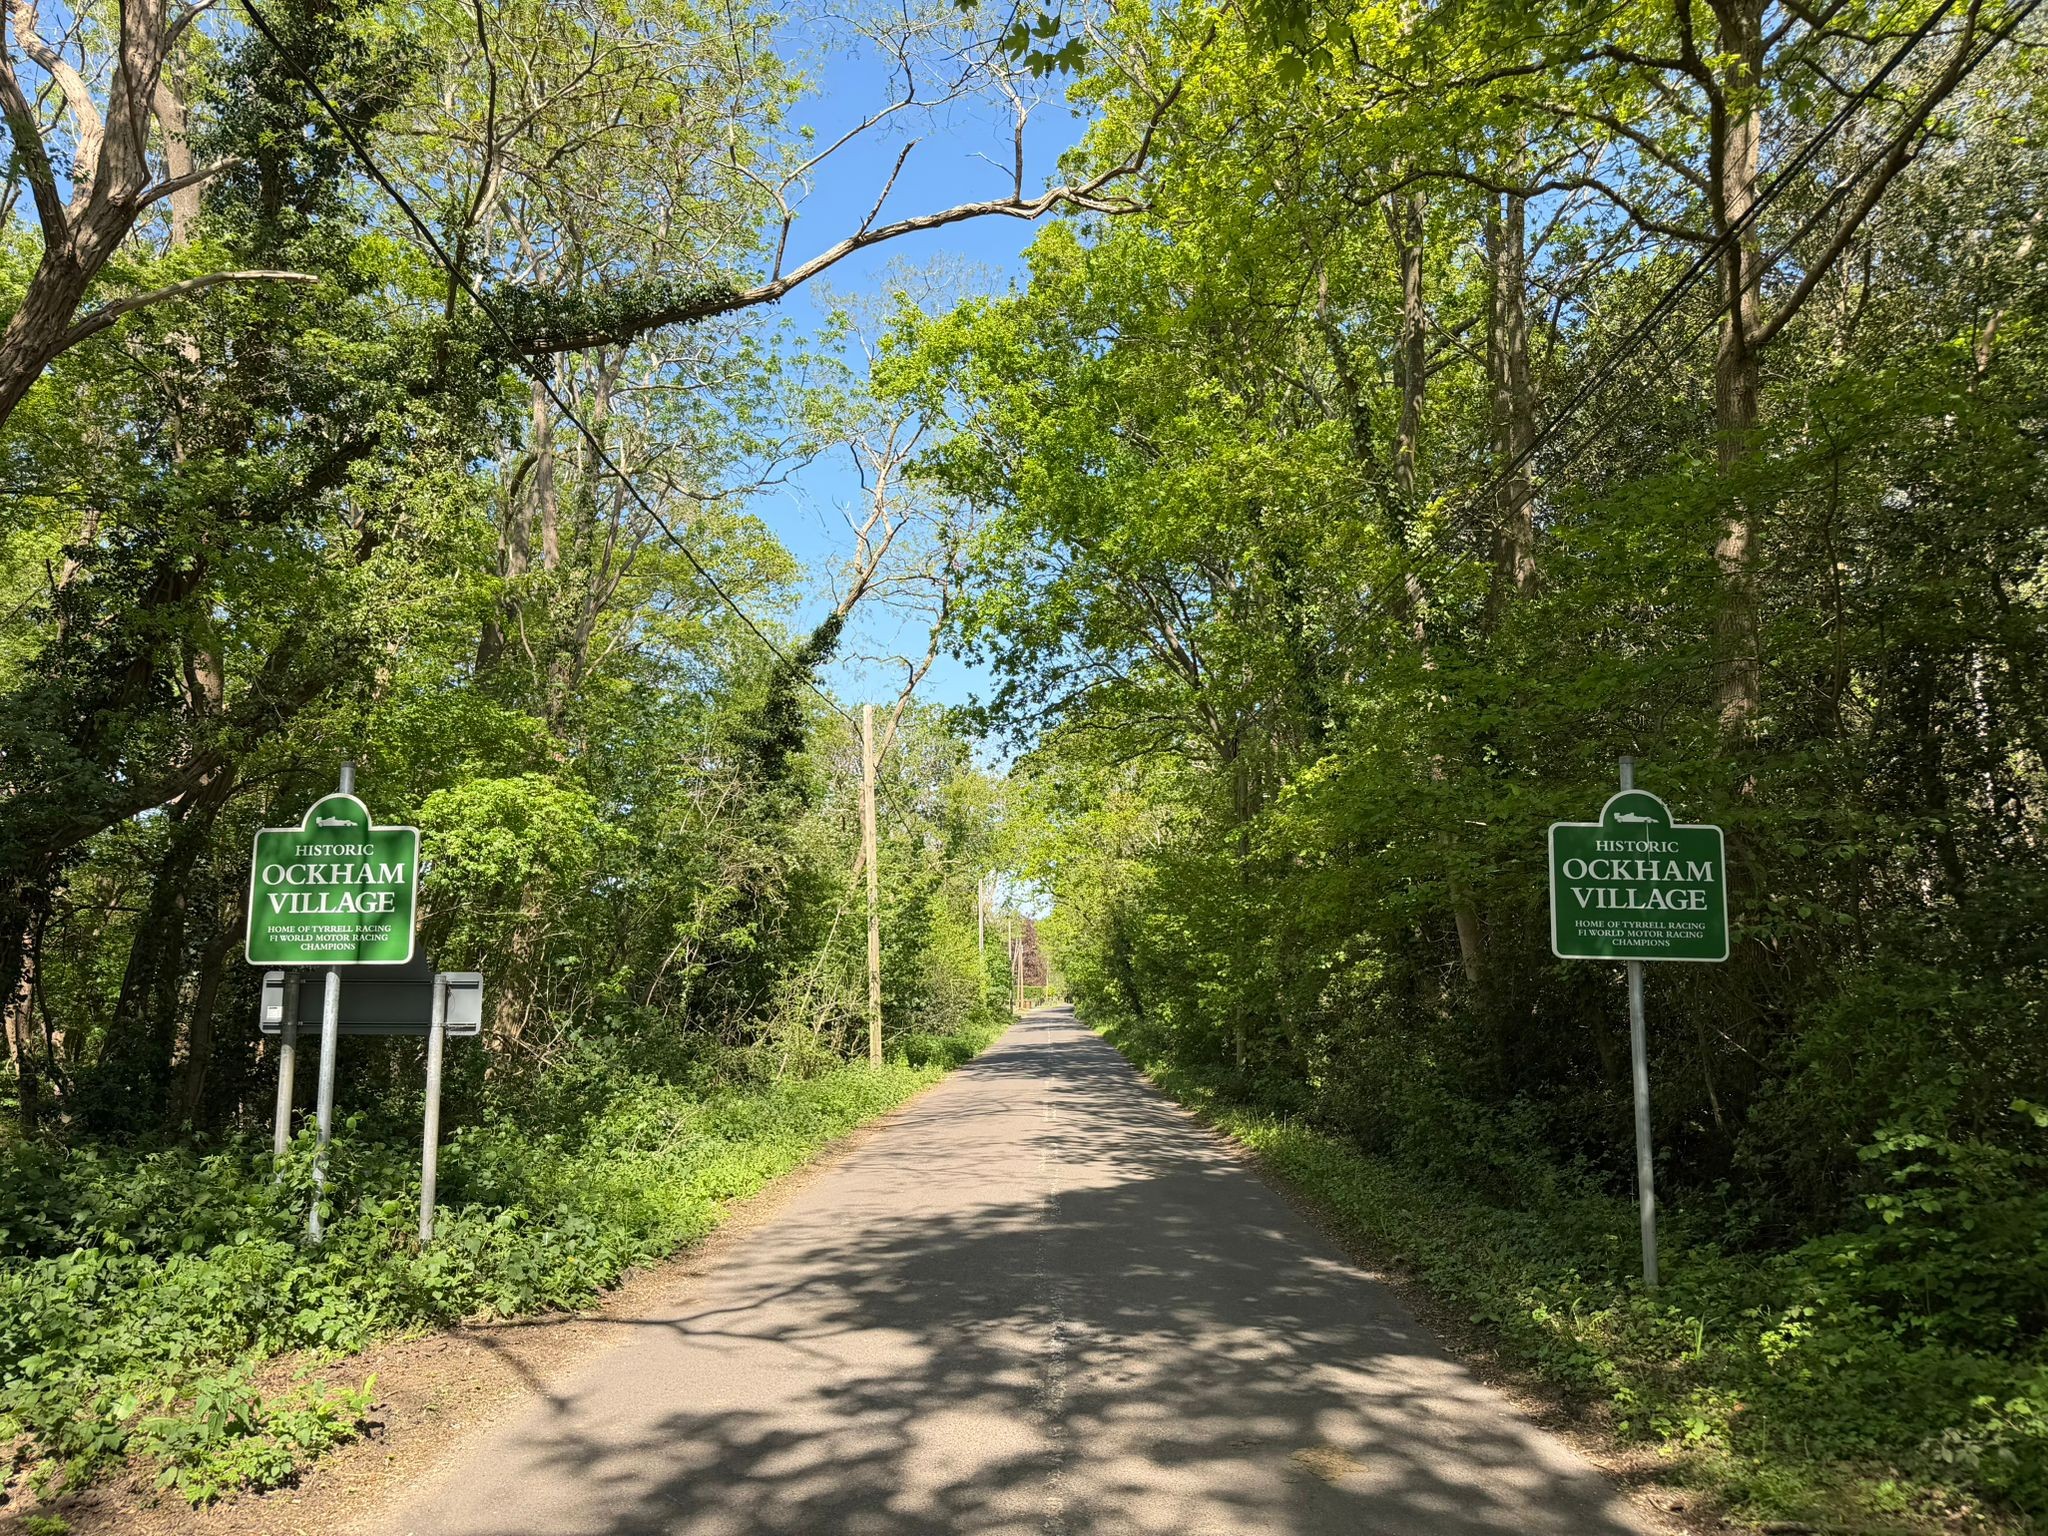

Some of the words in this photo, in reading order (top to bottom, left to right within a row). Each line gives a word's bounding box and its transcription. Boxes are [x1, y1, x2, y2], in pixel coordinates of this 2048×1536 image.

[295, 844, 374, 857] HISTORIC
[1595, 840, 1679, 853] HISTORIC
[262, 863, 406, 886] OCKHAM
[1562, 858, 1715, 882] OCKHAM
[267, 891, 395, 914] VILLAGE
[1570, 887, 1708, 911] VILLAGE
[267, 925, 296, 933] HOME
[297, 925, 311, 933] OF
[311, 925, 353, 933] TYRRELL
[355, 924, 391, 933] RACING
[1575, 920, 1605, 928] HOME
[1607, 920, 1621, 928] OF
[1621, 921, 1666, 929] TYRRELL
[1668, 922, 1706, 930] RACING
[279, 934, 313, 942] WORLD
[315, 934, 350, 942] MOTOR
[1588, 929, 1625, 937] WORLD
[1627, 930, 1664, 938] MOTOR
[1666, 930, 1704, 939] RACING
[300, 942, 356, 951] CHAMPIONS
[1612, 938, 1671, 947] CHAMPIONS
